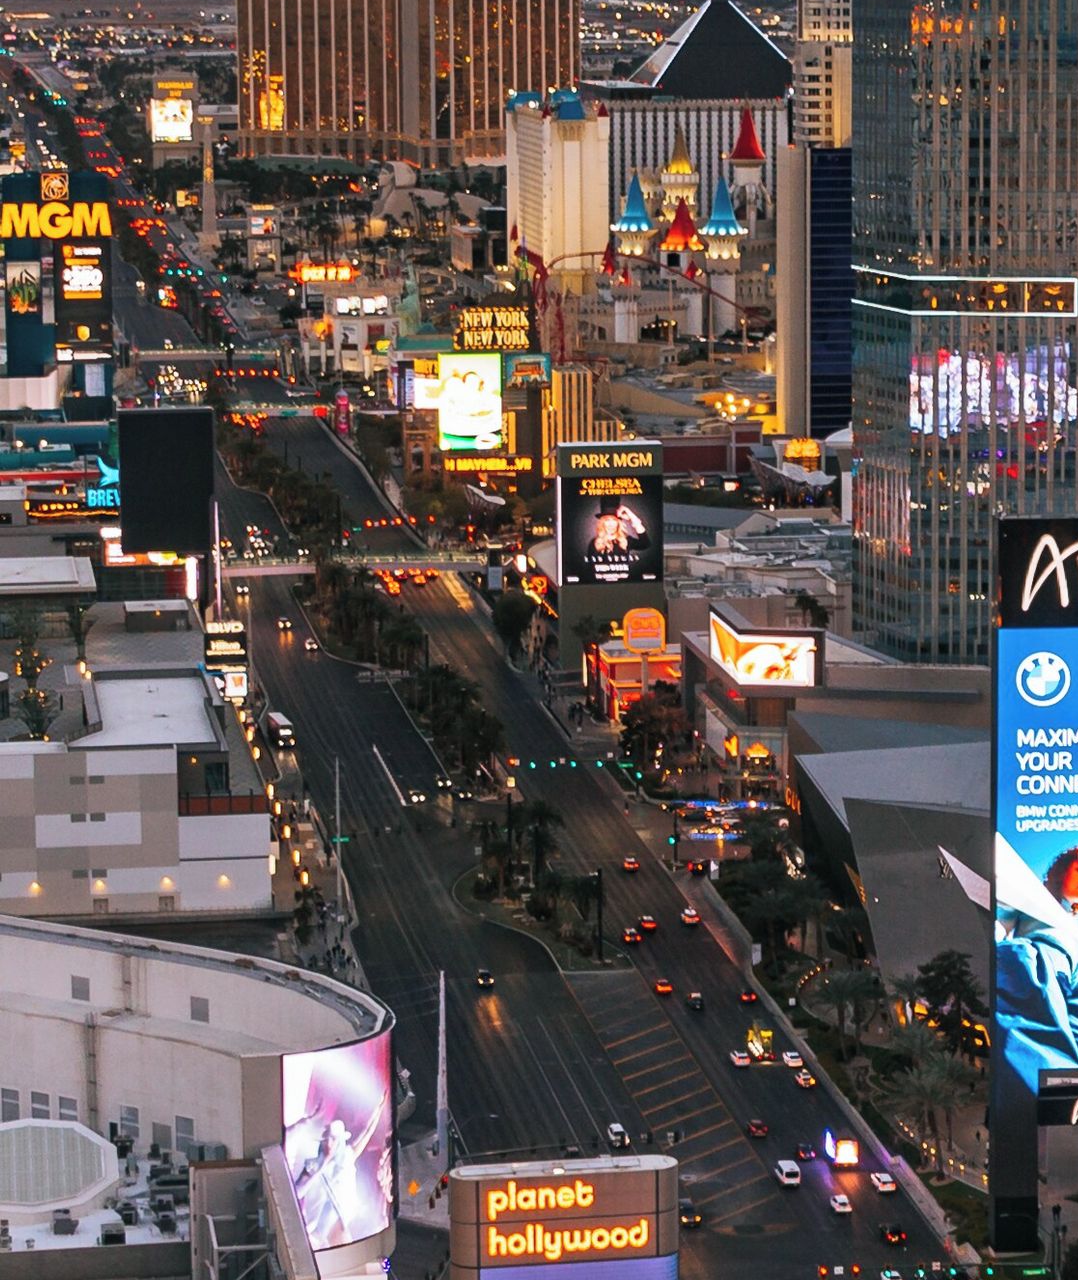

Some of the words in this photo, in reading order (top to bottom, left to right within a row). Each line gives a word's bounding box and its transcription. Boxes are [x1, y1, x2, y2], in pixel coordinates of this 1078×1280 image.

[0, 201, 112, 239] MGM
[464, 311, 493, 328] NEW
[495, 310, 529, 327] YORK
[464, 330, 493, 346] NEW
[495, 329, 529, 345] YORK
[571, 453, 610, 468] PARK
[613, 452, 653, 468] MGM
[1016, 751, 1073, 771] YOUR
[1016, 805, 1047, 818] BMW
[487, 1180, 594, 1221] planet
[488, 1219, 649, 1261] hollywood
